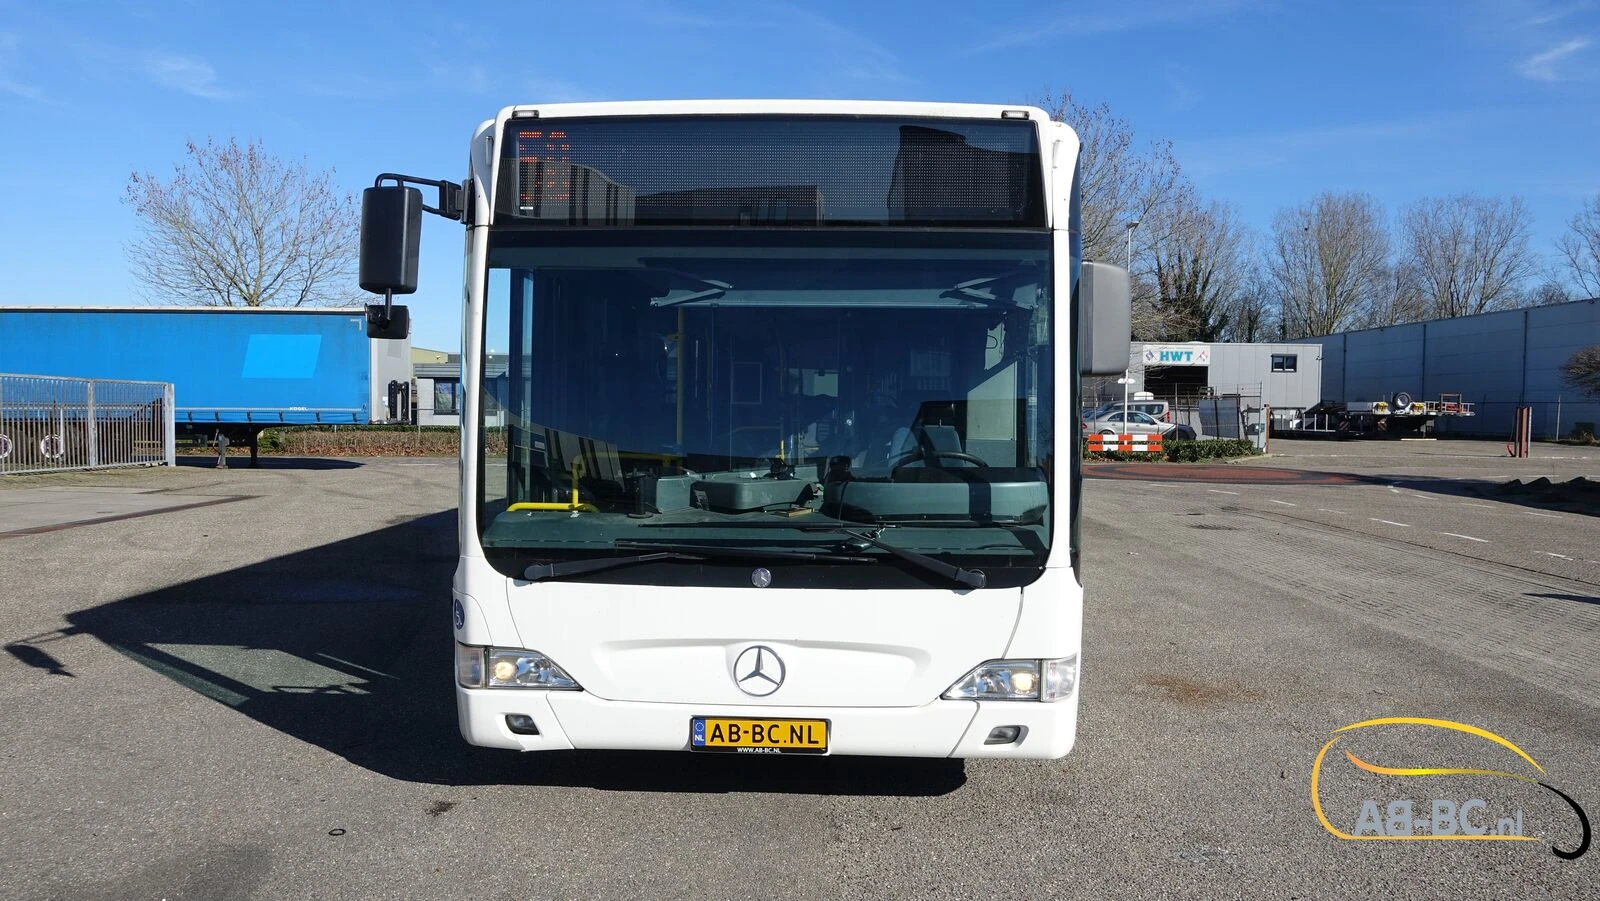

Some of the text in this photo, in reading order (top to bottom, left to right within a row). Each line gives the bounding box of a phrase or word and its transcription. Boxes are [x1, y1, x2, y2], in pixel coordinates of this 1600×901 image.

[1159, 351, 1193, 362] HWT
[694, 734, 704, 742] NL
[709, 723, 819, 744] AB-BC.NL
